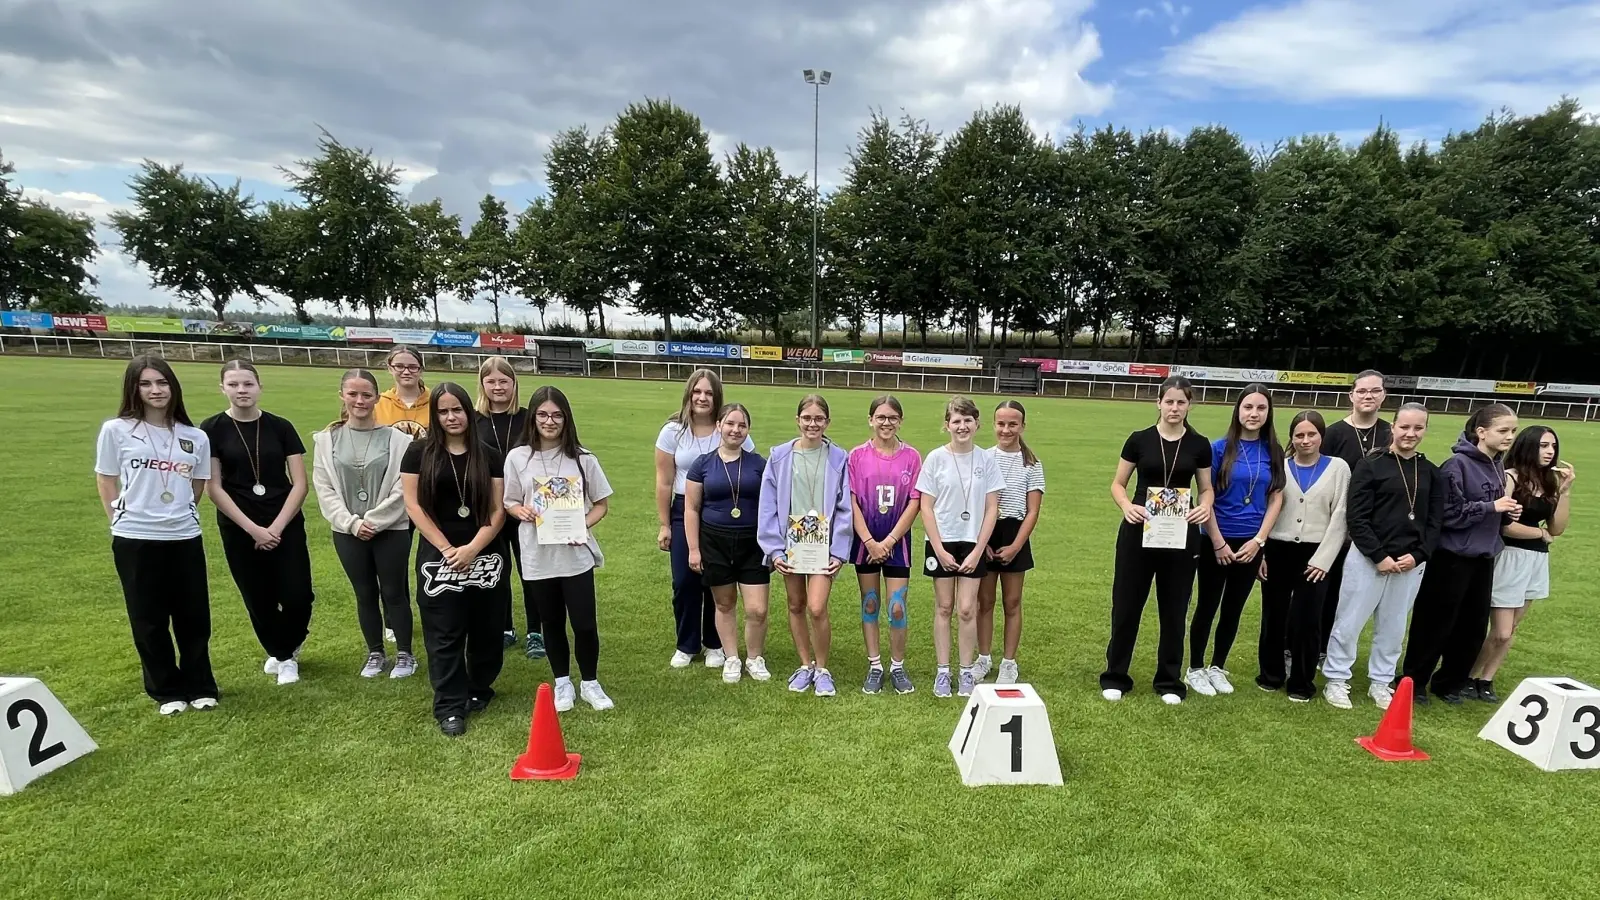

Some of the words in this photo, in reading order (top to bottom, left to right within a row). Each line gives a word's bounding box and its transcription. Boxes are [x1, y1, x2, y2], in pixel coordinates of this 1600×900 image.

[53, 316, 88, 327] REWE
[272, 325, 300, 333] Distner
[682, 344, 725, 354] Nordoberpfalz
[787, 348, 819, 358] WEMA
[911, 355, 942, 364] Gleißner
[876, 485, 895, 507] 13
[1507, 694, 1549, 745] 3
[7, 699, 67, 767] 2
[1570, 705, 1600, 760] 3
[1000, 715, 1022, 772] 1
